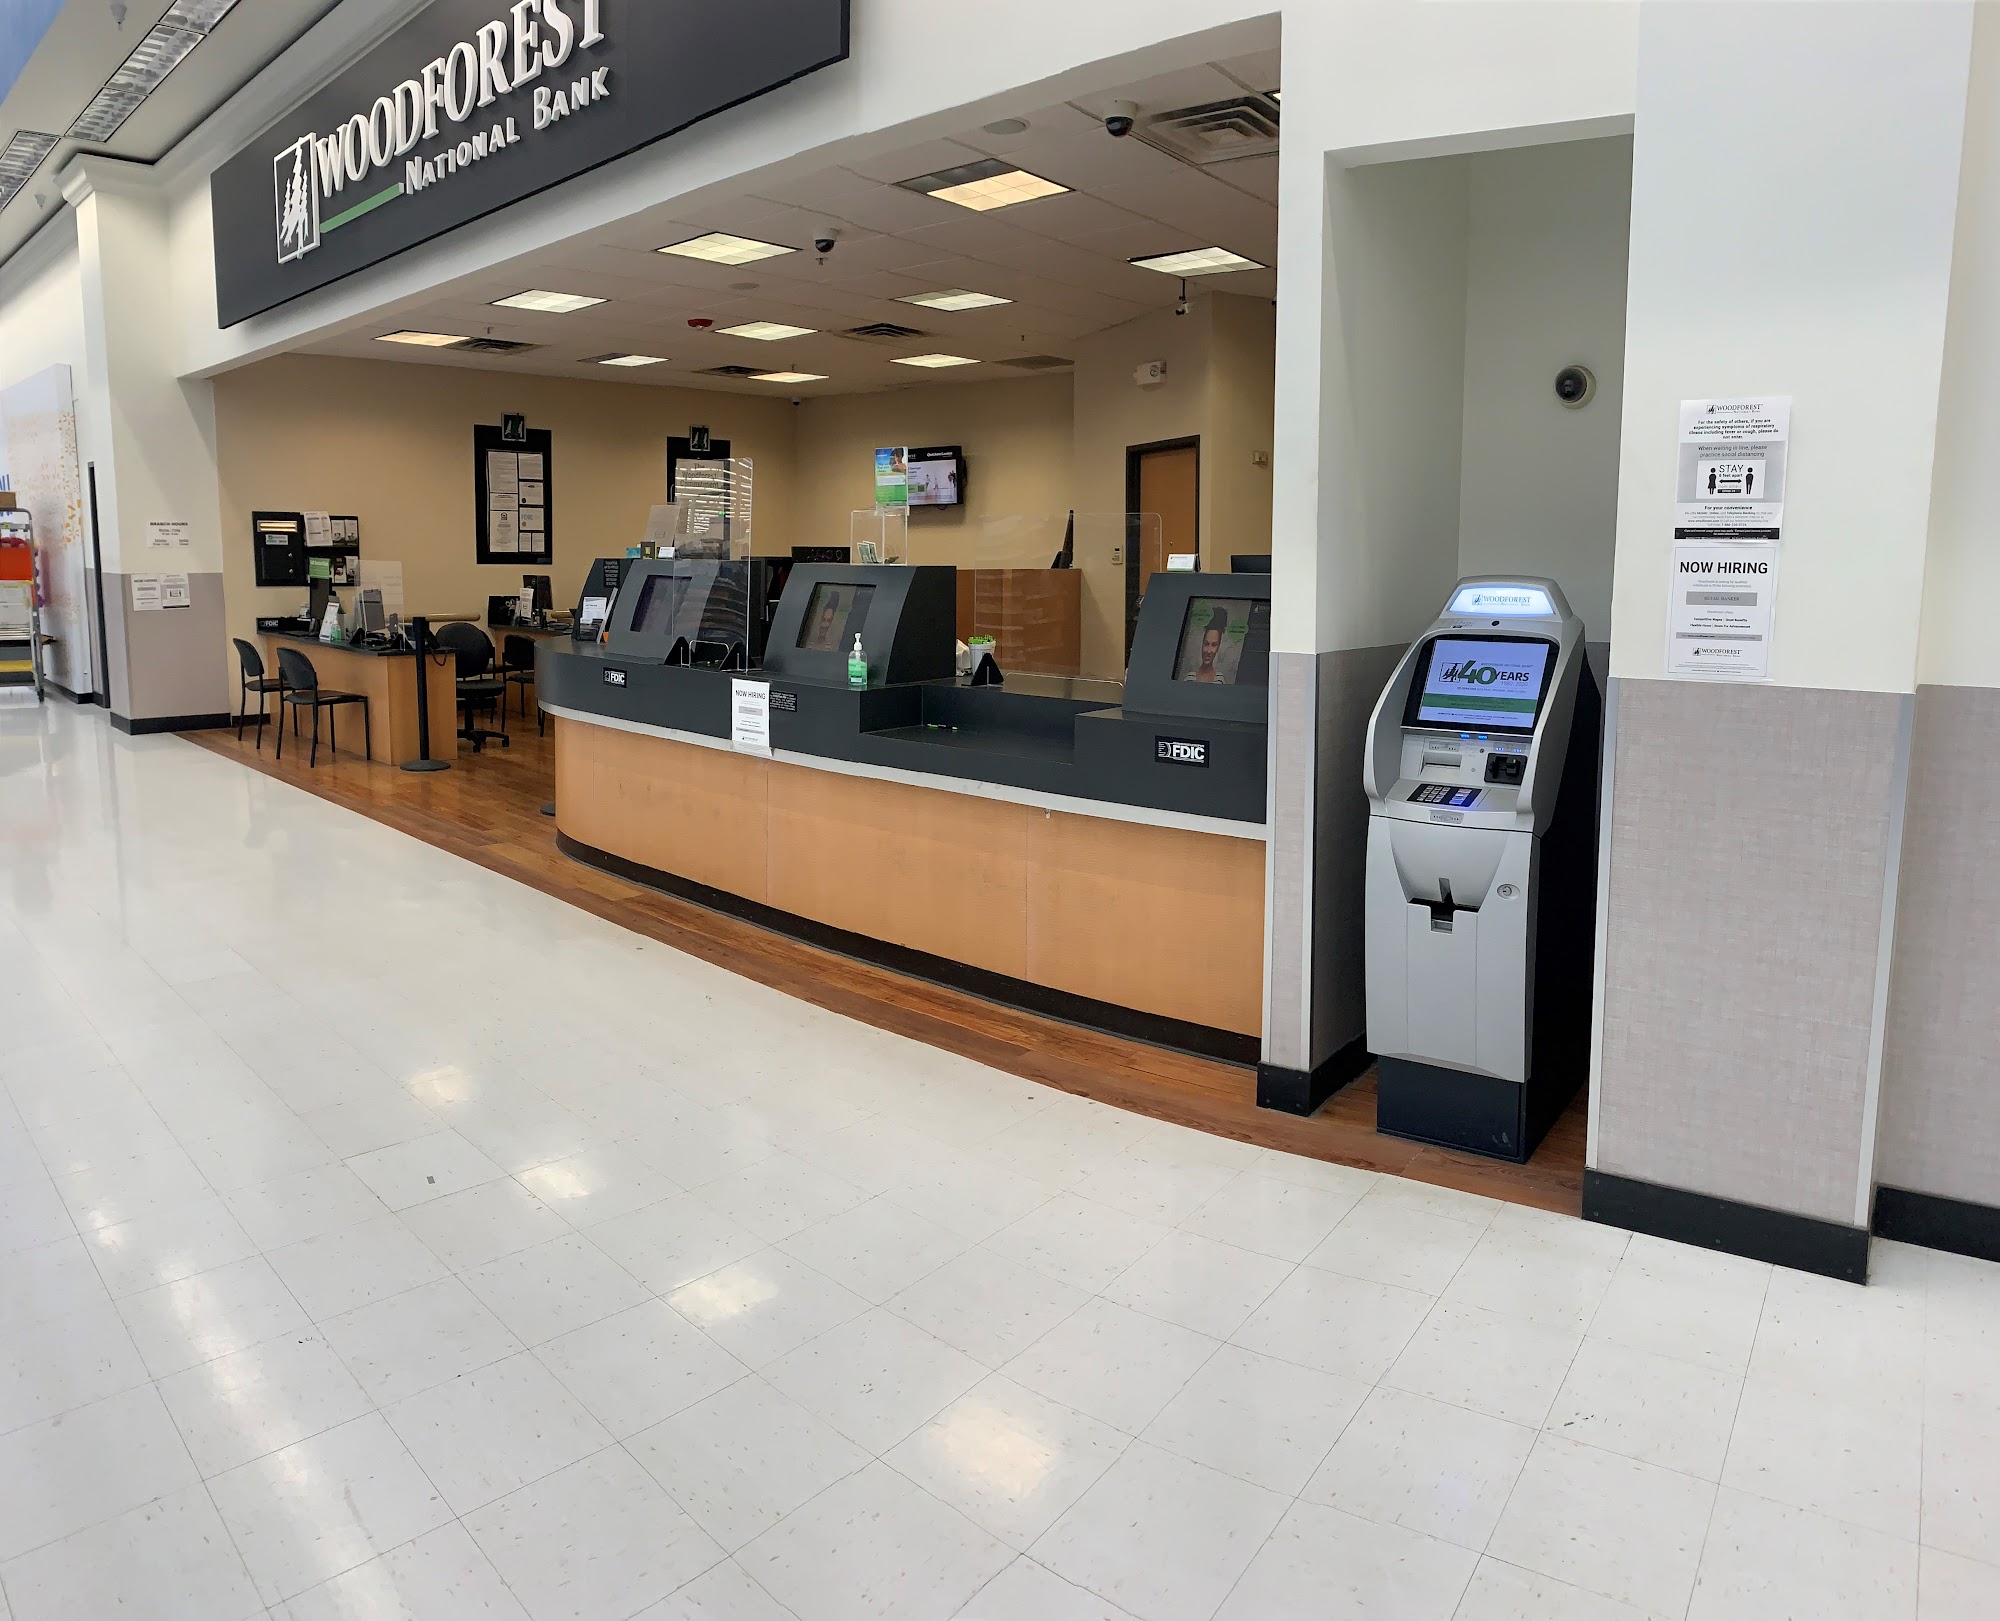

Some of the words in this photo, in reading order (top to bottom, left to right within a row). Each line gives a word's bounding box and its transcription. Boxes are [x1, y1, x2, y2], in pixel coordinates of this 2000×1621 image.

[316, 0, 604, 196] WOODFOREST
[406, 117, 520, 194] NATIONAL
[533, 66, 609, 130] BANK
[1680, 562, 1713, 573] NOW
[1718, 563, 1768, 574] HIRING
[611, 673, 625, 683] FDIC
[1458, 660, 1497, 684] 40
[1495, 672, 1530, 681] YEARS
[1173, 745, 1205, 760] FDIC
